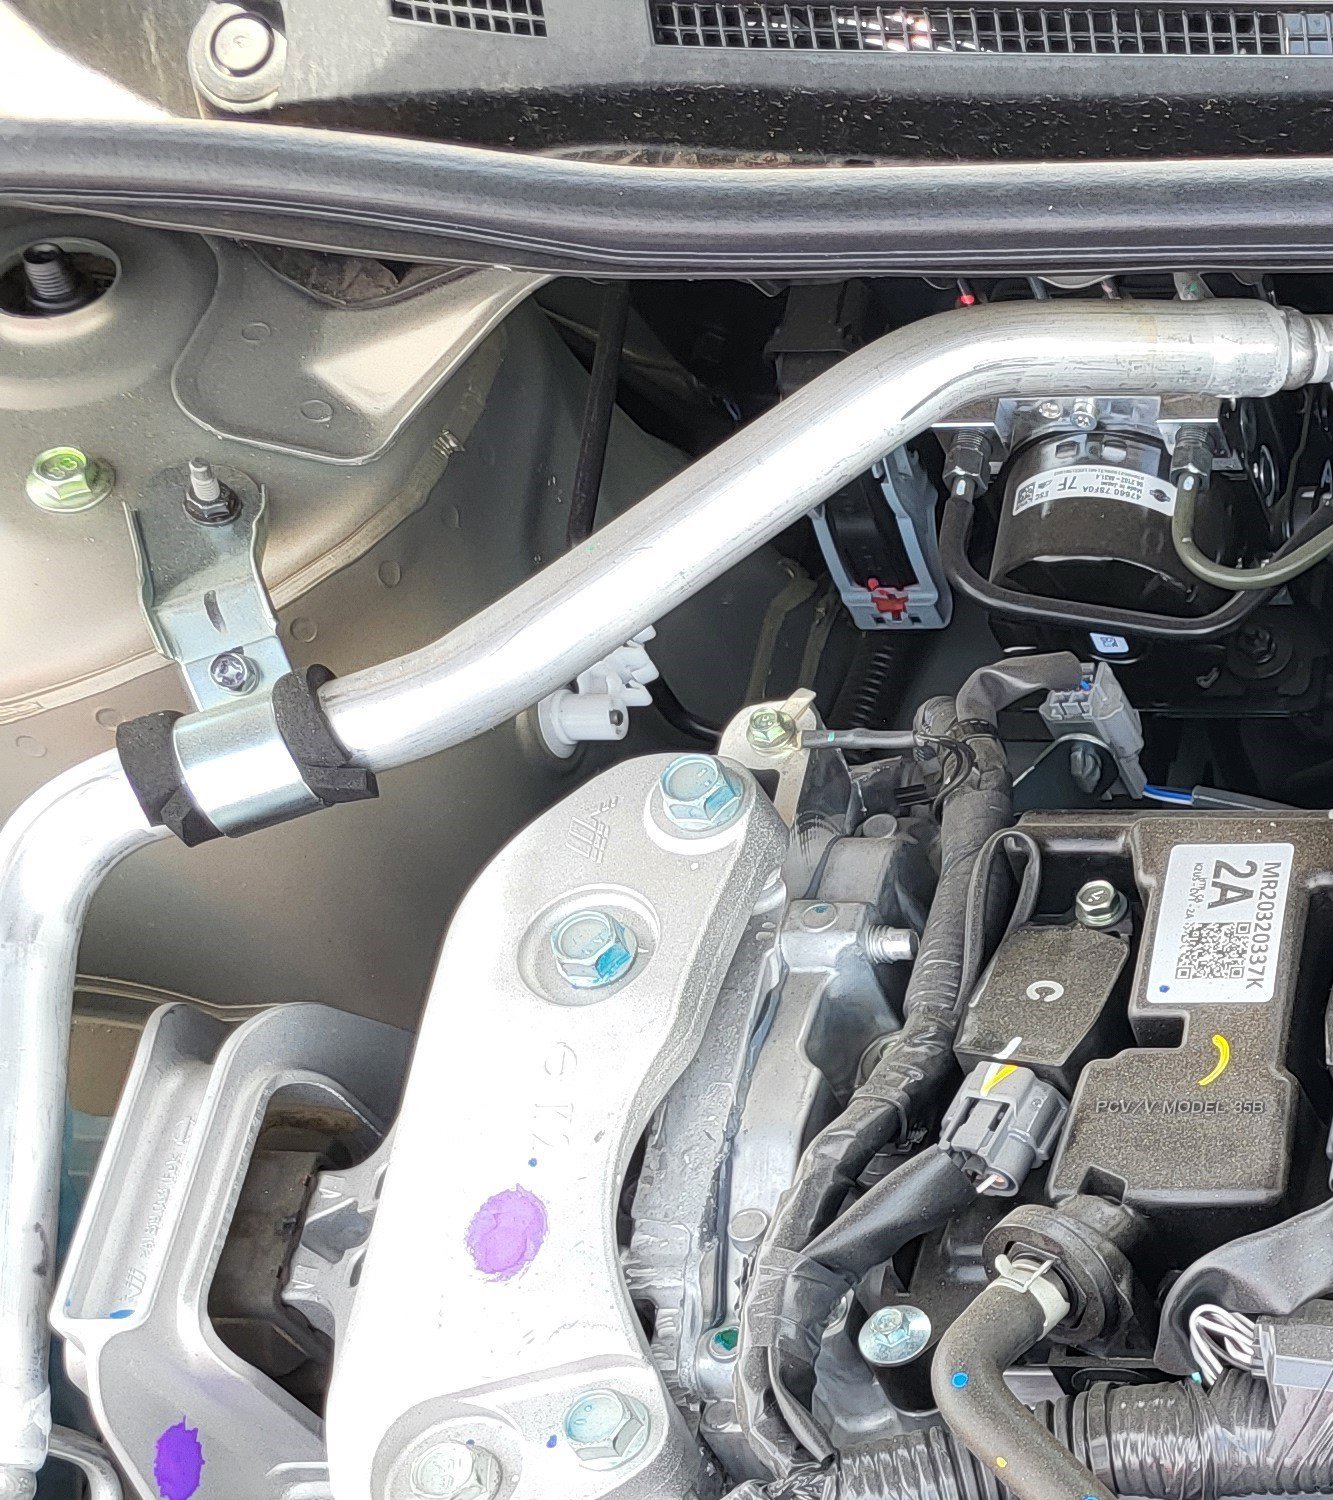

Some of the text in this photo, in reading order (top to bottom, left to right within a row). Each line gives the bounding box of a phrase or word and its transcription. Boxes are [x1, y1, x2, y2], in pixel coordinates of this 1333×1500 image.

[1057, 476, 1077, 491] 7F
[1207, 860, 1258, 909] 2A
[1246, 862, 1281, 989] MR20320337K
[1161, 1099, 1226, 1115] MODEL
[1233, 1099, 1264, 1114] 35B
